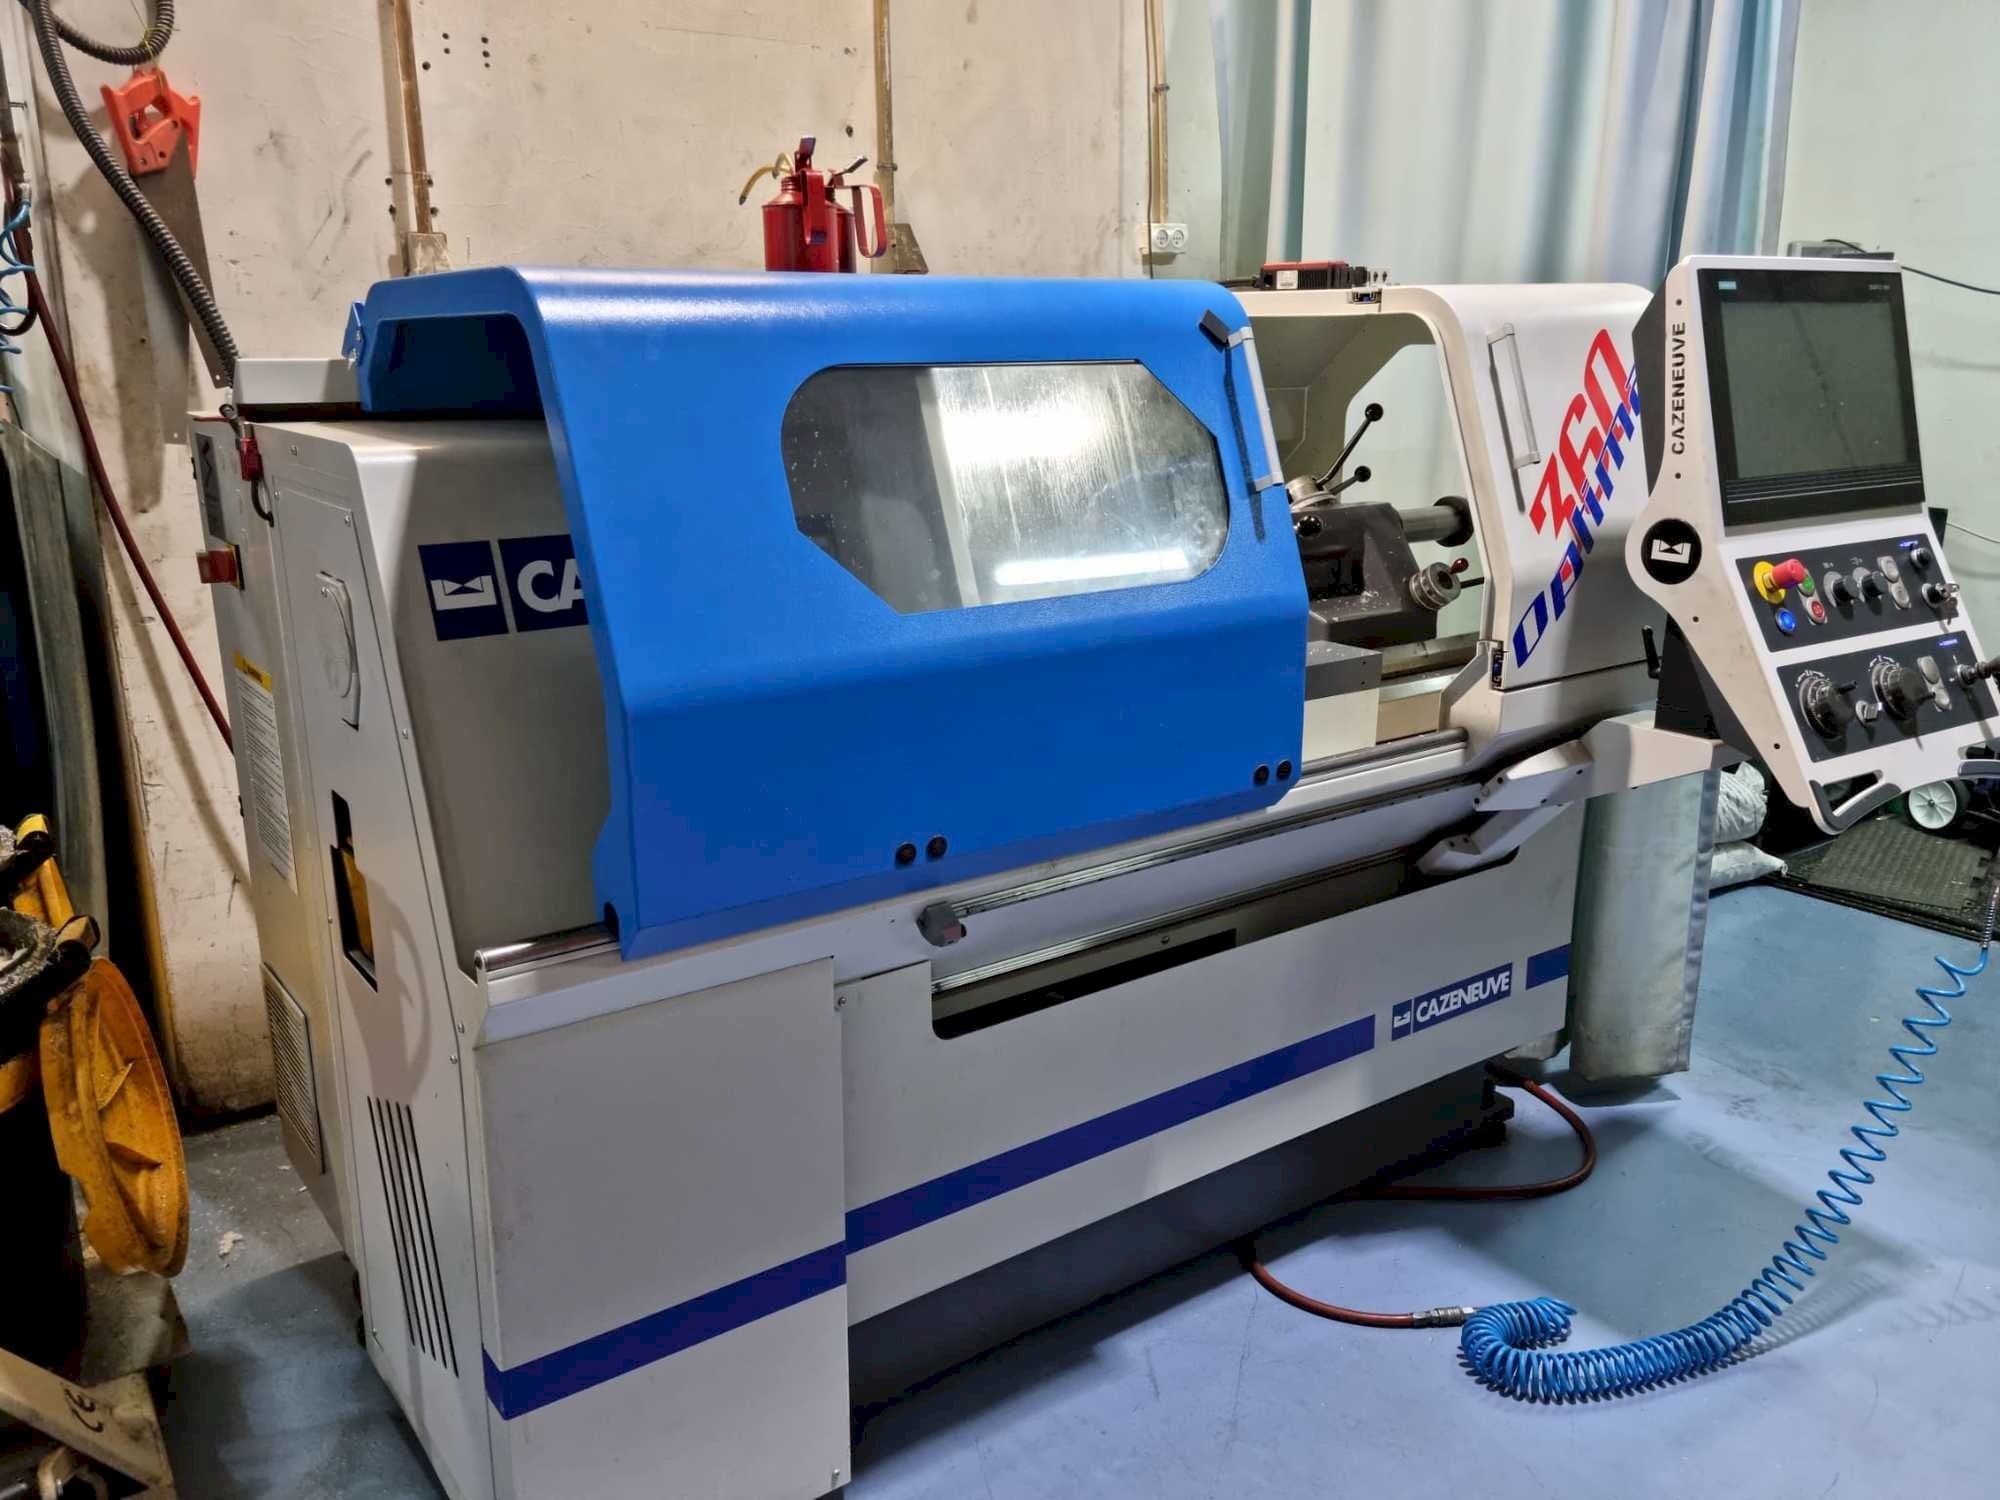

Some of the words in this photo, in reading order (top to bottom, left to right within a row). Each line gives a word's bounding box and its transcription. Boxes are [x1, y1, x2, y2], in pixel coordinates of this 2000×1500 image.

[1530, 328, 1631, 550] 360
[1671, 322, 1685, 455] CAZENEUVE
[1416, 971, 1510, 1022] CAZENEUVE
